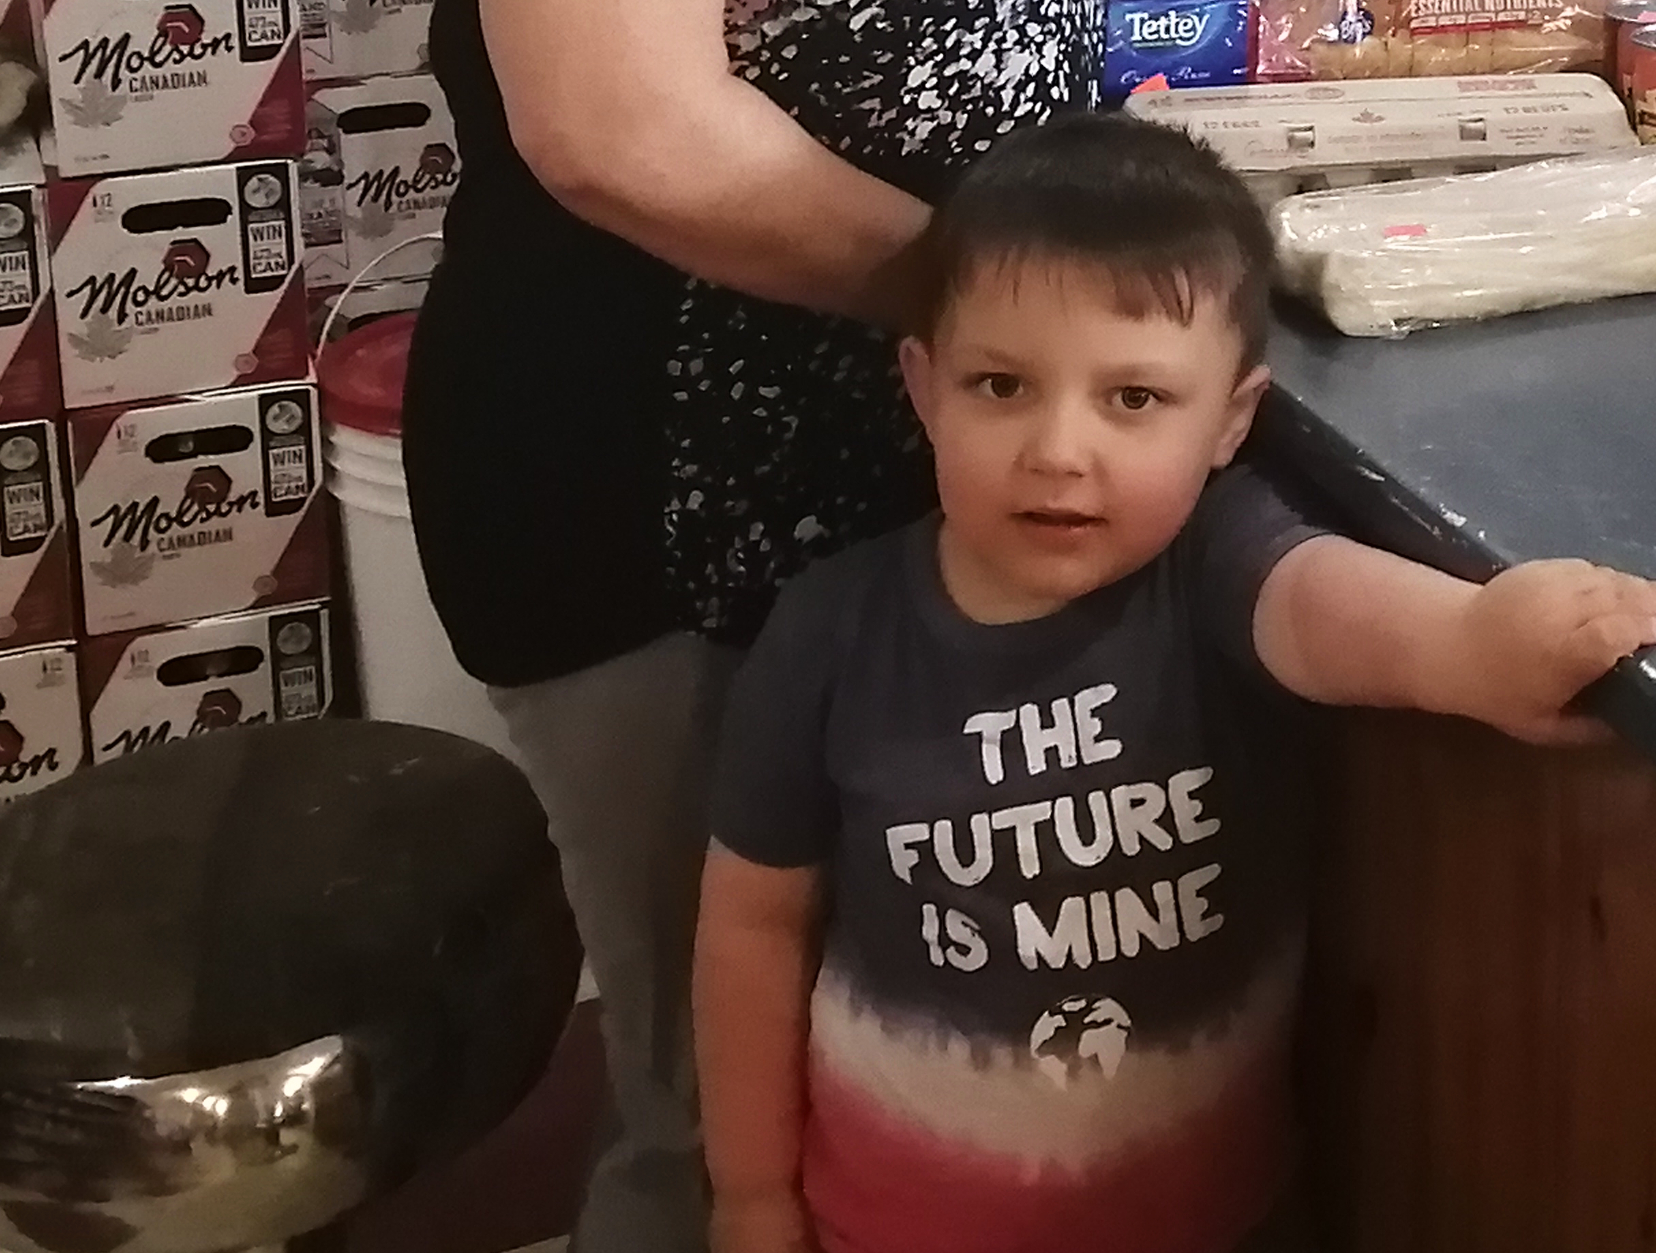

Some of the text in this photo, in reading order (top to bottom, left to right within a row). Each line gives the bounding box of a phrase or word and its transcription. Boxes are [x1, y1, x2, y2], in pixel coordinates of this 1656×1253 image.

[248, 27, 283, 44] CAN
[1124, 10, 1211, 46] Tetley
[57, 32, 236, 93] Molson
[129, 69, 208, 93] CANADIAN
[250, 225, 284, 244] WIN
[251, 260, 287, 275] CAN
[64, 264, 241, 327] Molson
[133, 301, 214, 328] CANADIAN
[271, 448, 304, 466] WIN
[4, 486, 42, 506] WIN
[90, 489, 260, 554] Molson
[156, 525, 235, 553] CANADIAN
[962, 682, 1123, 785] THE
[885, 765, 1222, 888] FUTURE
[921, 861, 1225, 973] IS MINE
